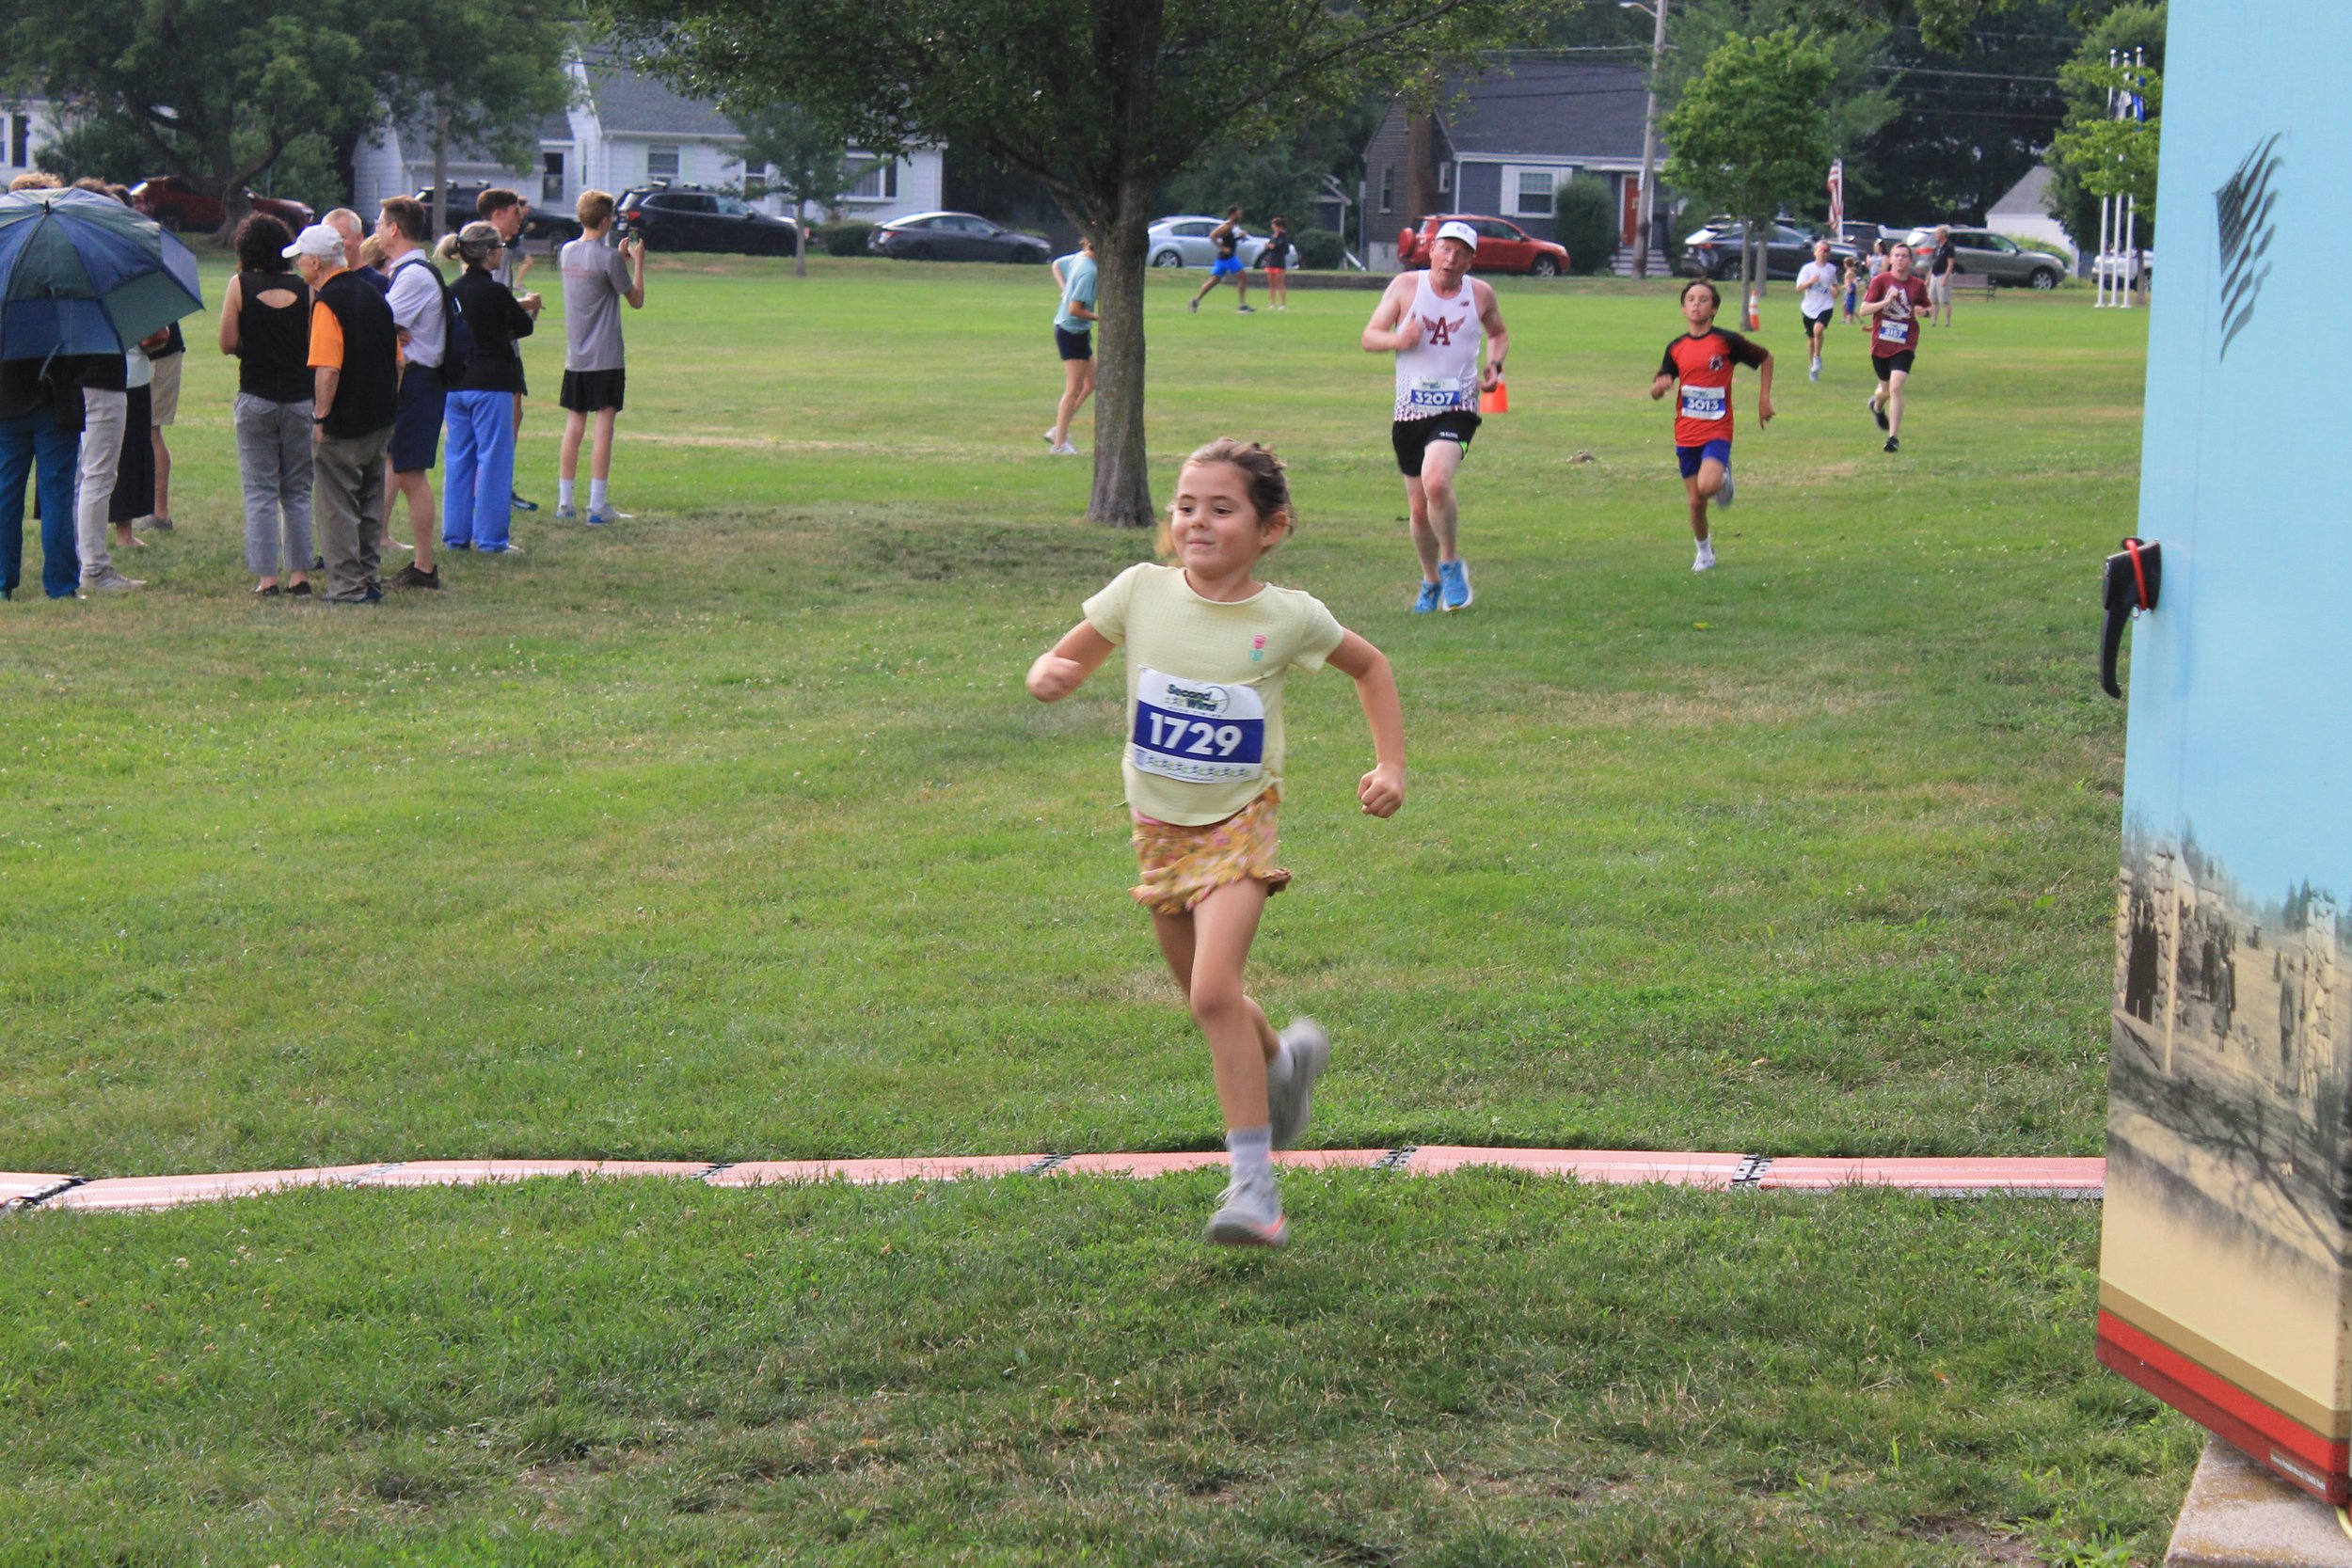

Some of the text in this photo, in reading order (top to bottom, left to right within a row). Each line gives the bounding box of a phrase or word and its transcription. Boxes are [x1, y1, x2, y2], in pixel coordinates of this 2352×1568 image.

[1415, 391, 1454, 405] 3207
[1687, 398, 1720, 411] 3013
[1168, 684, 1213, 701] Second
[1187, 698, 1218, 712] Wind
[1150, 711, 1243, 756] 1729
